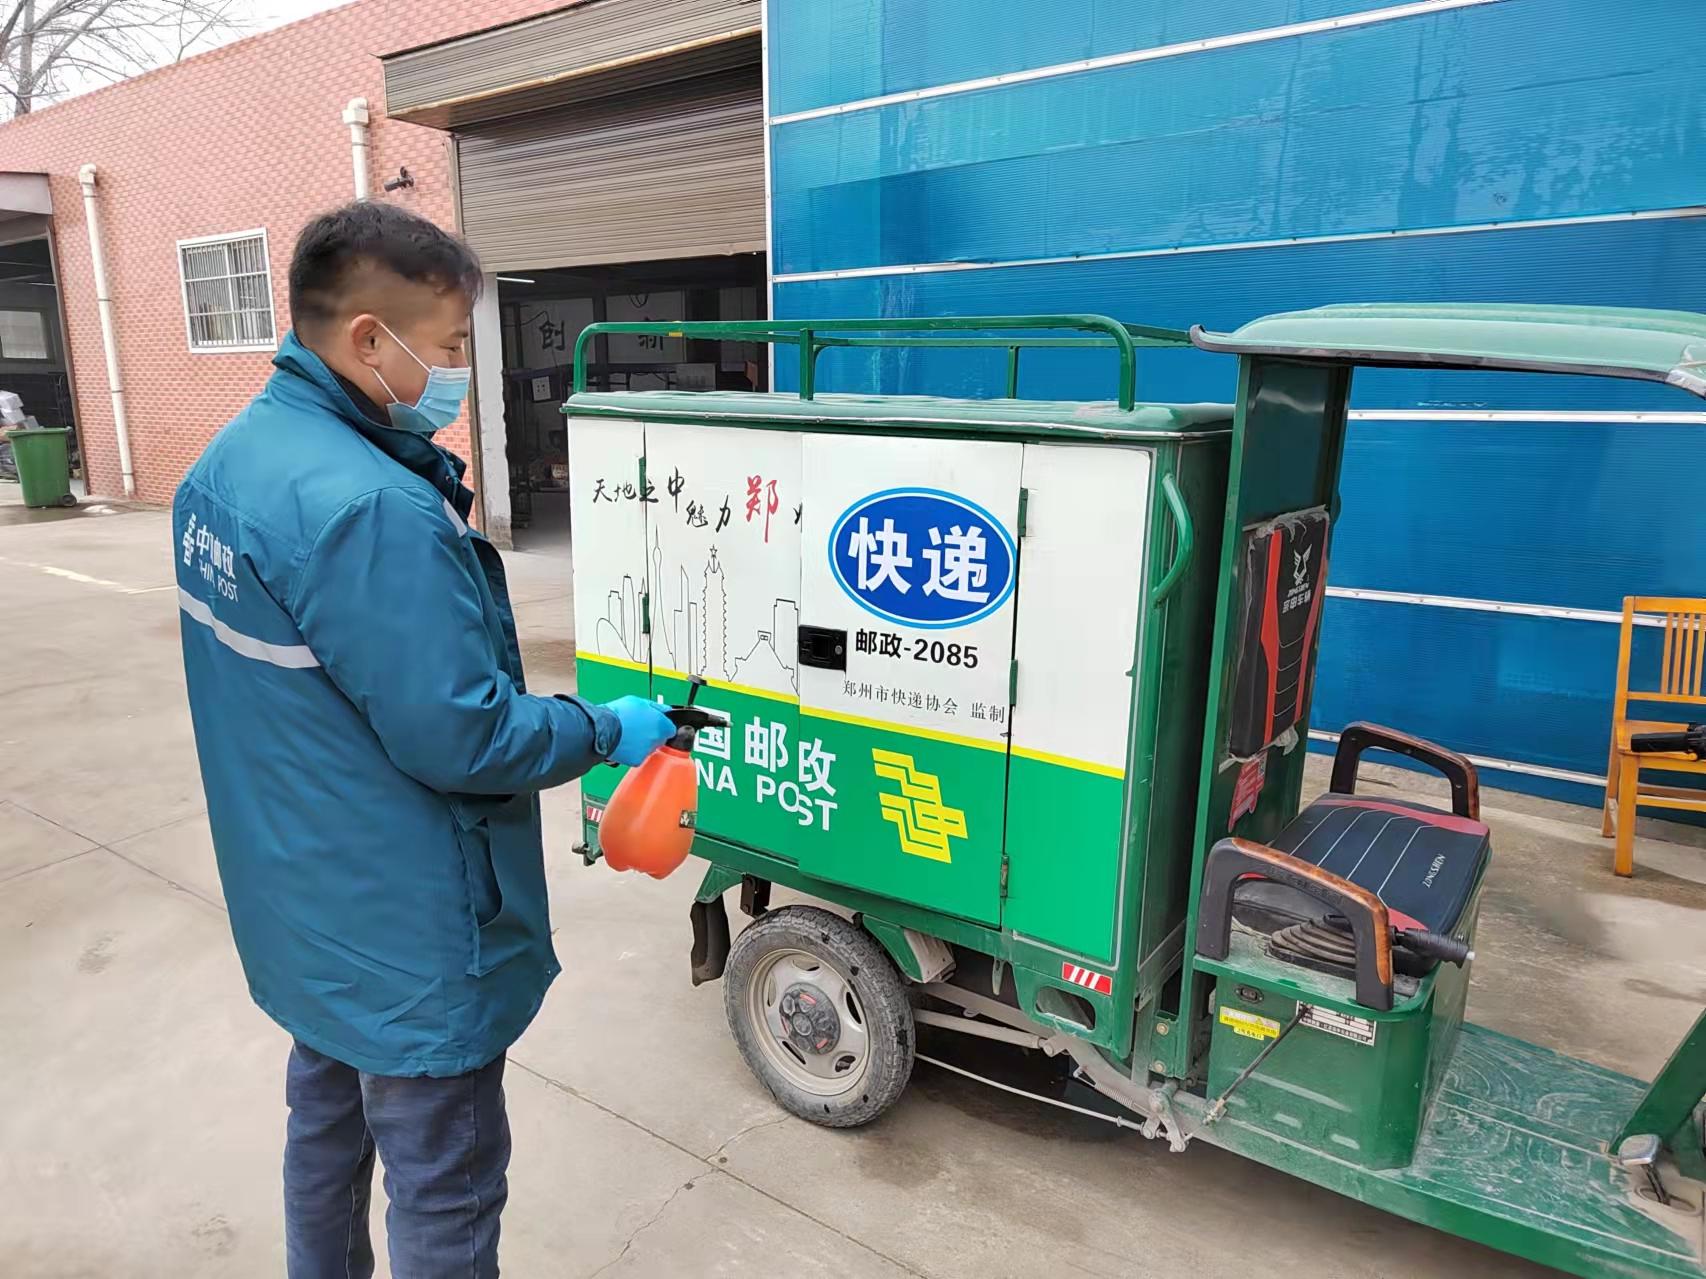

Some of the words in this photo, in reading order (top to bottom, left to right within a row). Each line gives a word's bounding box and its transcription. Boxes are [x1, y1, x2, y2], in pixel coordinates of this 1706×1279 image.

[592, 466, 685, 514] 天地之中
[846, 515, 993, 605] 快递
[855, 628, 979, 669] 邮政-2085
[842, 680, 959, 716] 郑州市快递协会
[969, 702, 1006, 724] 监制
[656, 694, 837, 797] 国邮政
[756, 774, 838, 832] POST
